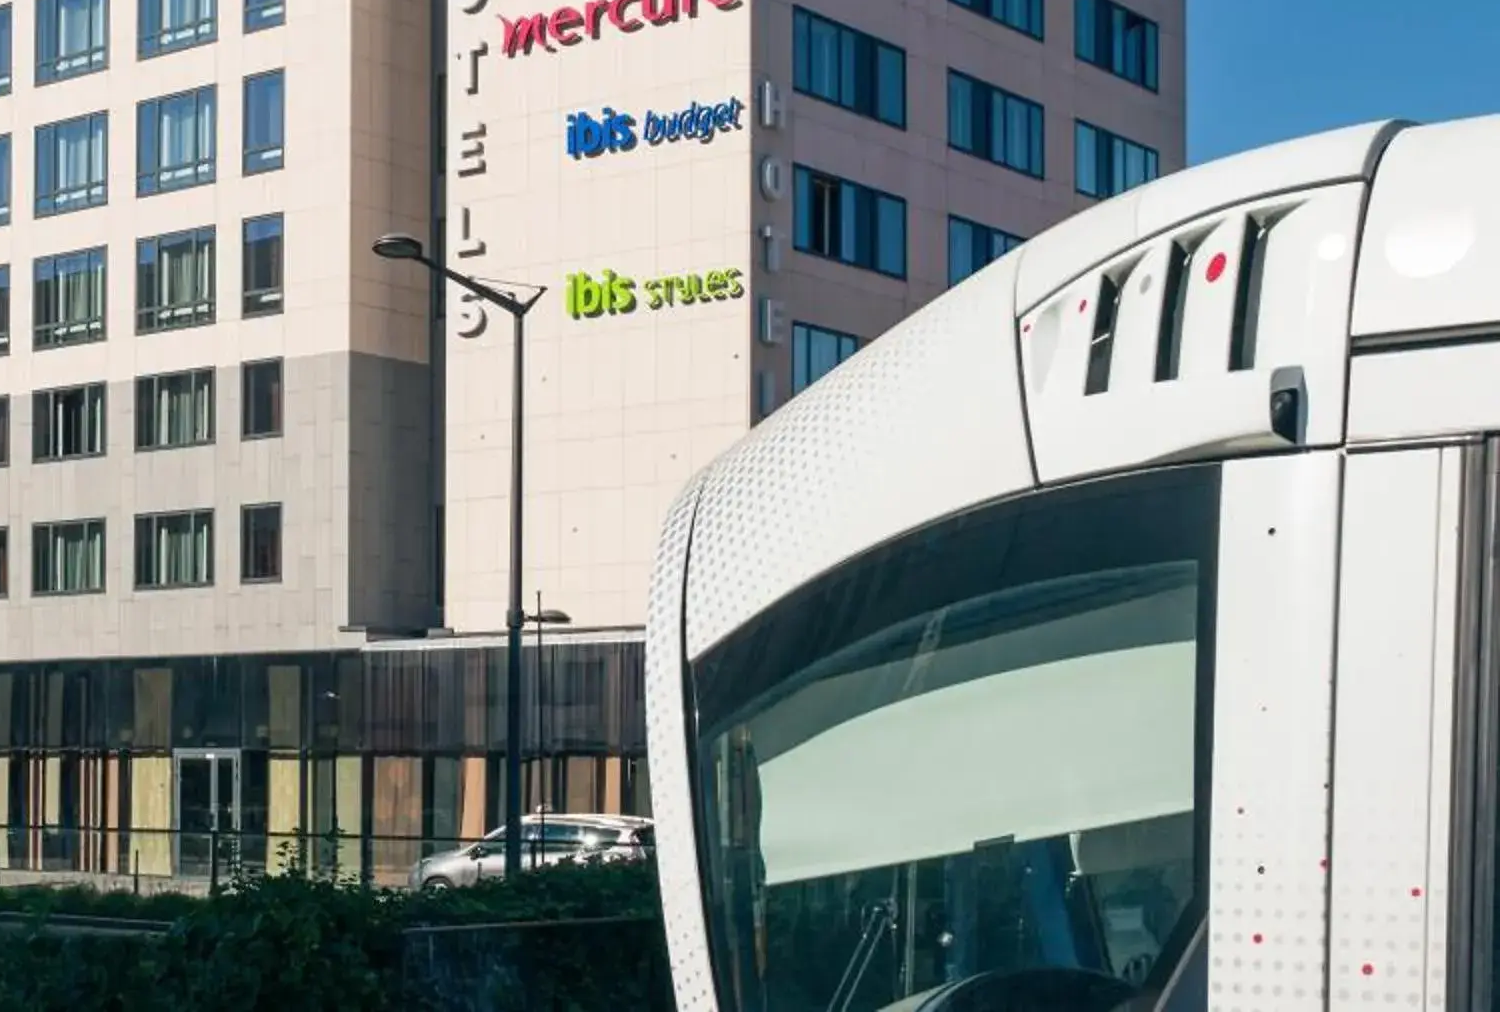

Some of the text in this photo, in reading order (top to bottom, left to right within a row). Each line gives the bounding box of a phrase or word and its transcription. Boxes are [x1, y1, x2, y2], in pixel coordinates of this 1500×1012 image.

[566, 96, 745, 160] ibis budget
[565, 268, 637, 320] ibis
